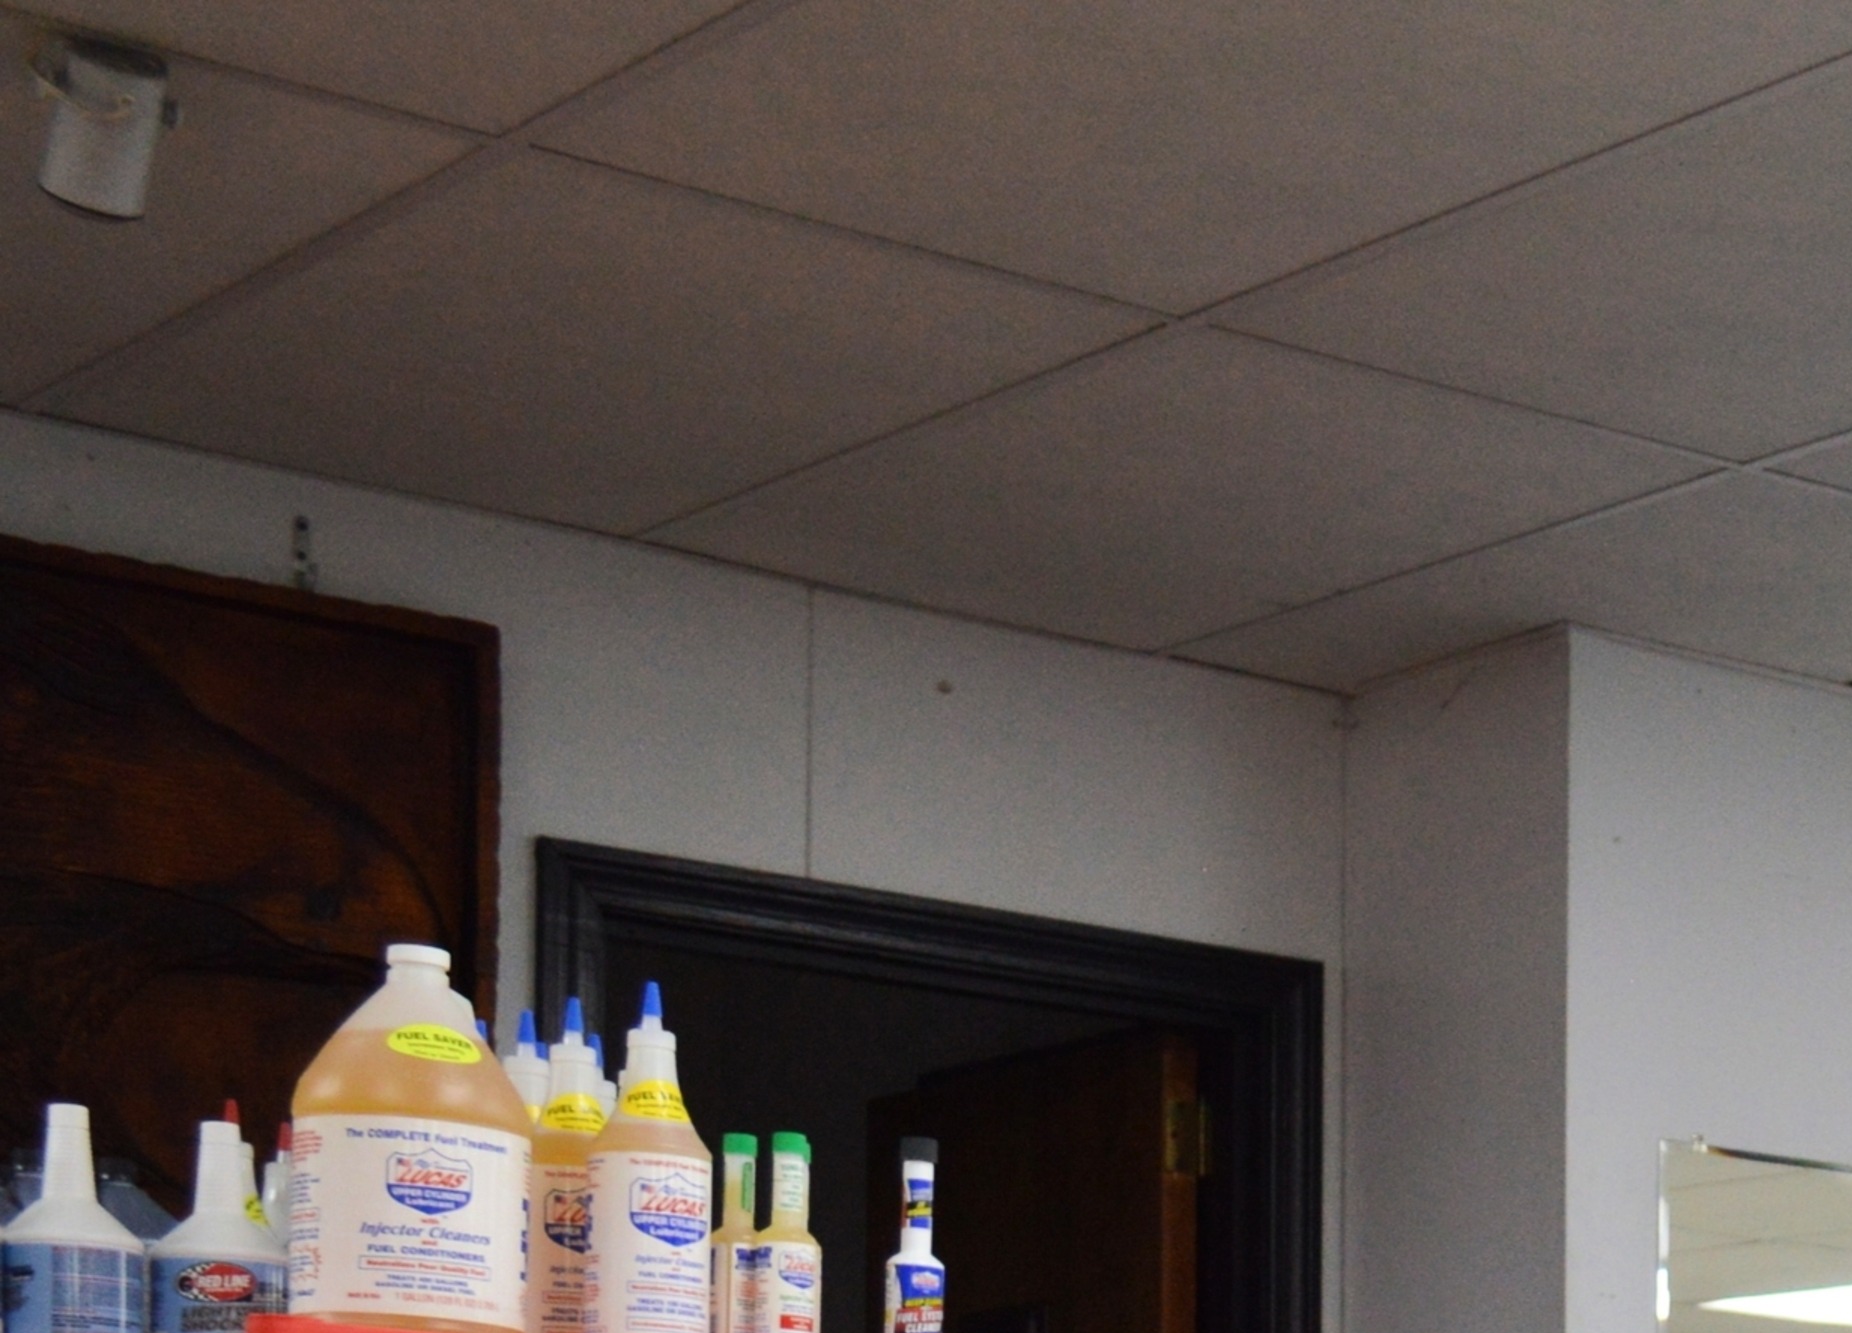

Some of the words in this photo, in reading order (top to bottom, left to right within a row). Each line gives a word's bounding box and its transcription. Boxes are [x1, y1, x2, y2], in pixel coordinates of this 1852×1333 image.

[396, 1031, 429, 1042] FUEL
[433, 1033, 473, 1050] SAVER
[367, 1129, 430, 1142] COMPLETE
[434, 1134, 459, 1146] Fuel
[395, 1167, 468, 1188] LUCAS
[641, 1196, 707, 1219] LUCAS
[359, 1222, 423, 1237] Injector
[428, 1227, 491, 1245] Cleaners
[367, 1244, 396, 1254] FUEL
[401, 1246, 486, 1263] CONDITIONERS
[198, 1274, 222, 1288] RED
[223, 1274, 252, 1288] LINE
